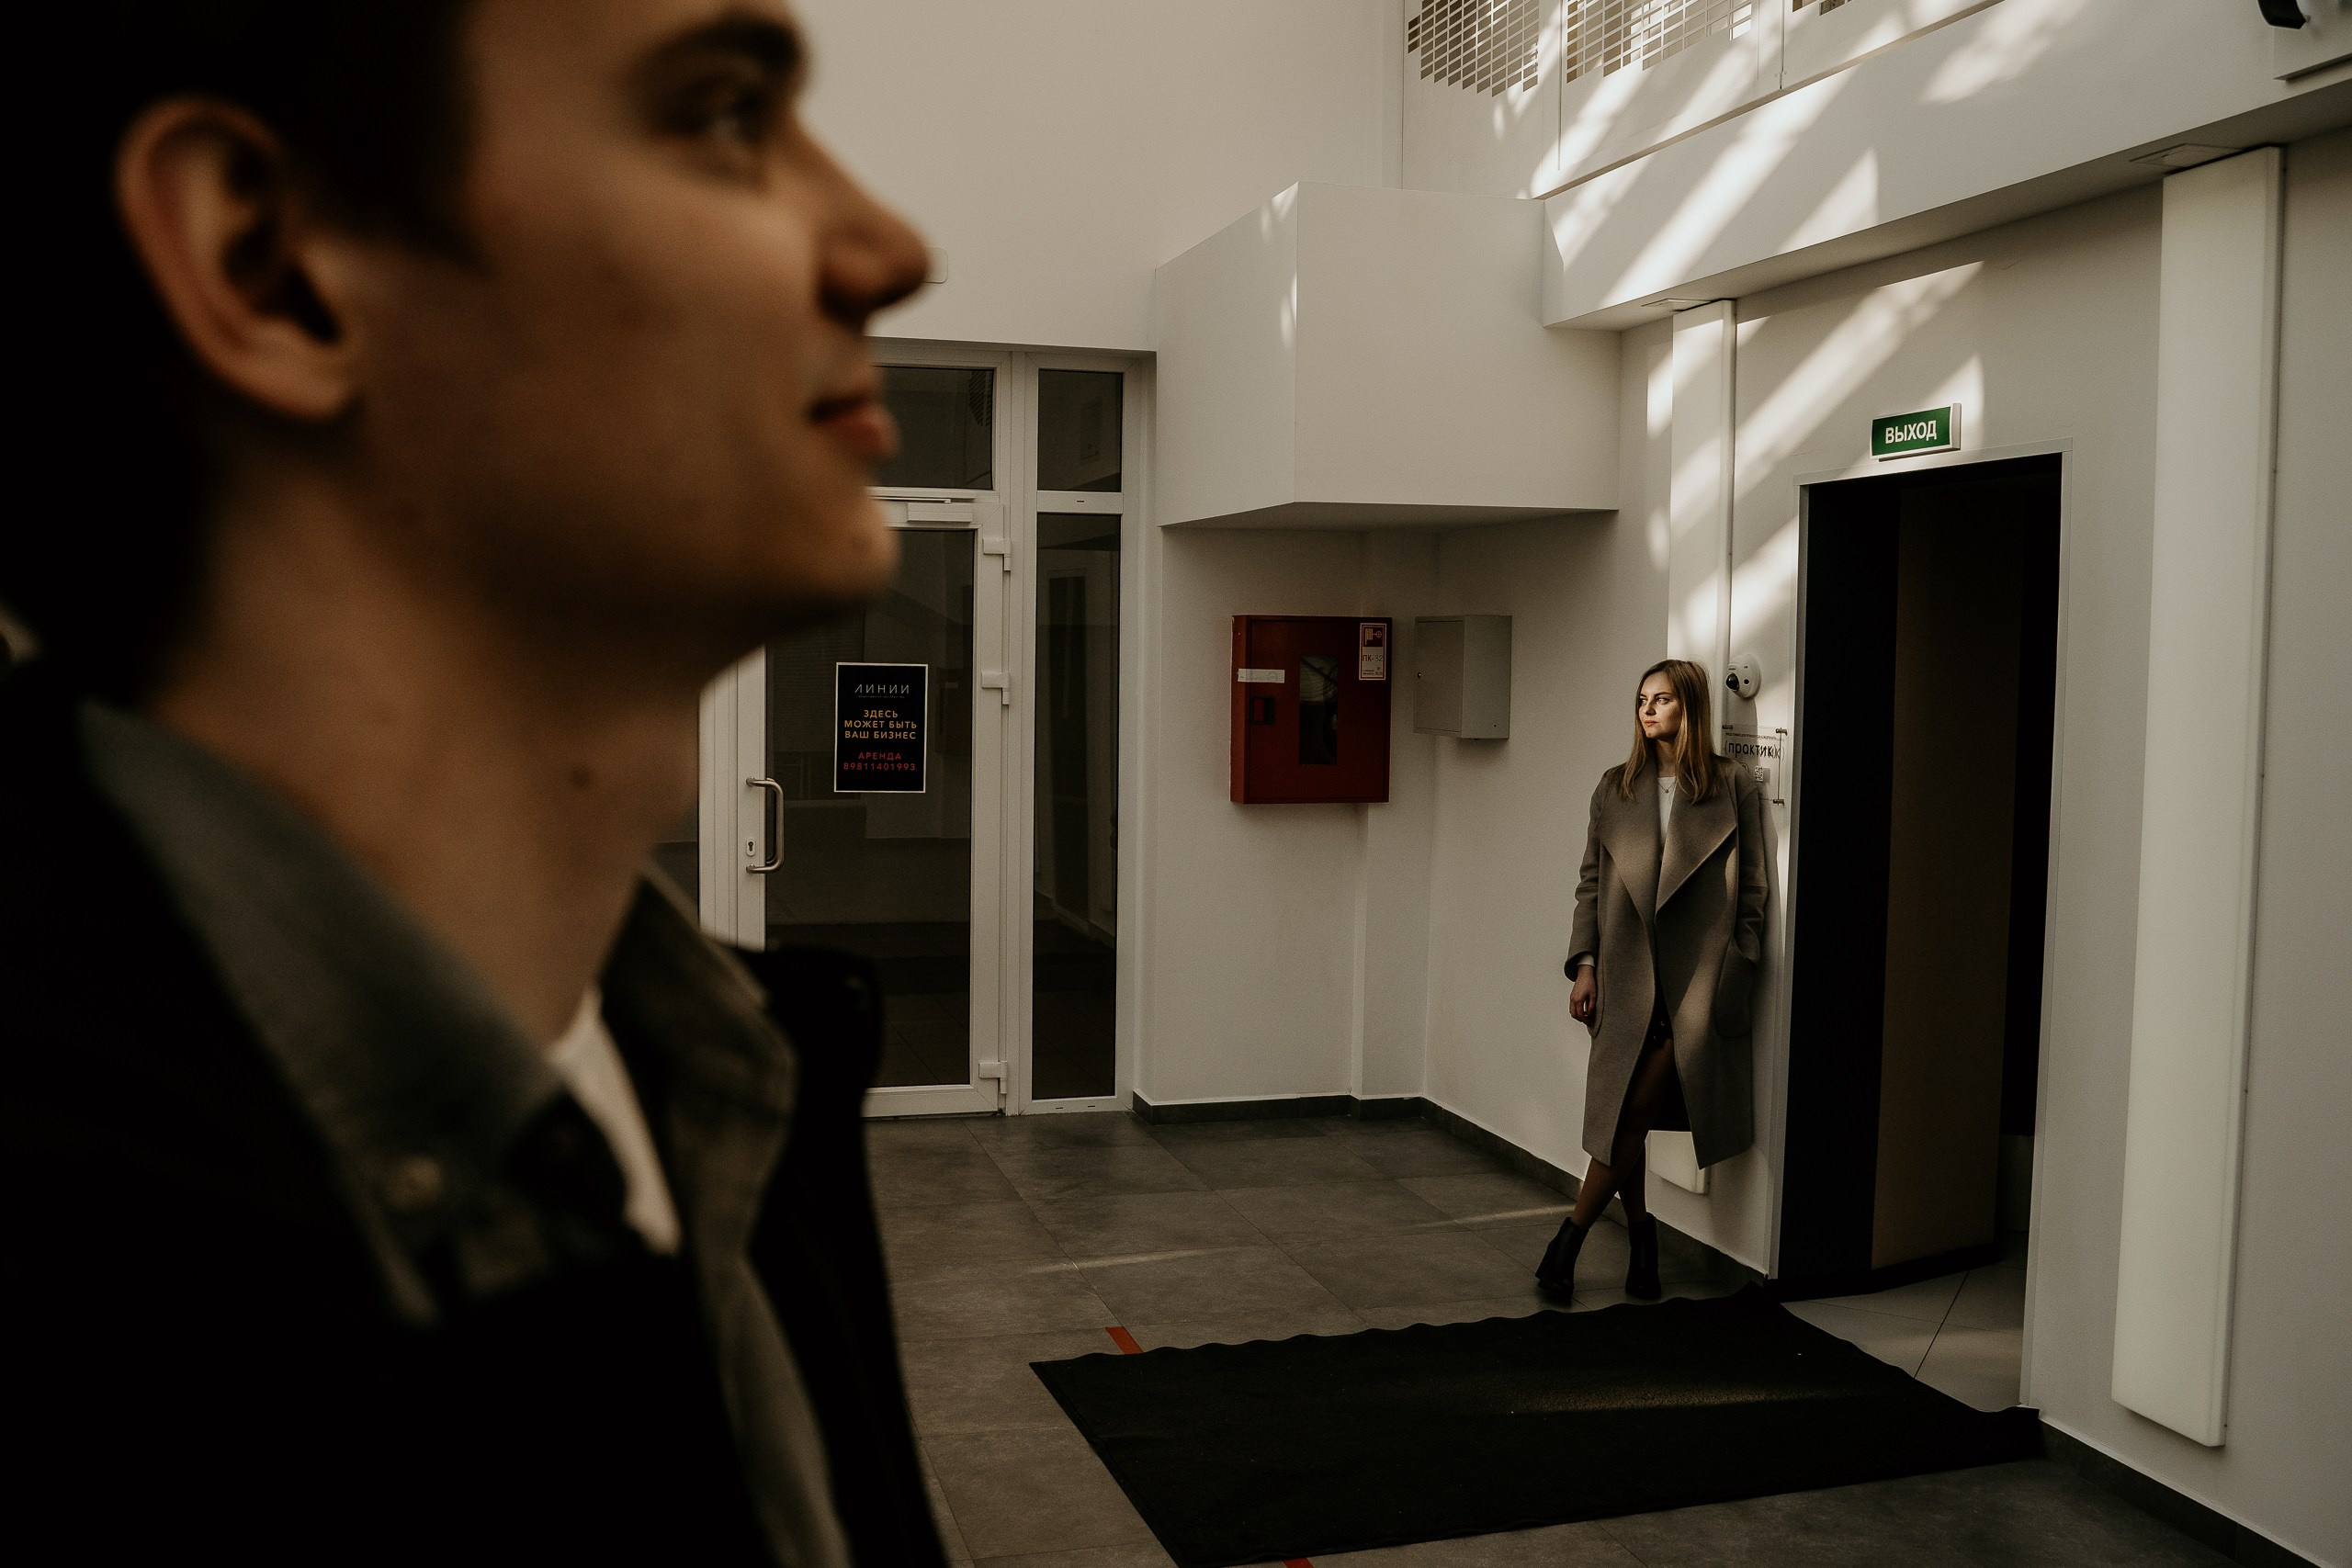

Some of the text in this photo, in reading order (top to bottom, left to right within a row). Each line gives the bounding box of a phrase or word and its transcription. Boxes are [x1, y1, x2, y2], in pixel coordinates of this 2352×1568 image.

[1885, 420, 1937, 444] ВЫХОД
[854, 683, 910, 694] ЛИНИИ
[864, 709, 898, 718] ЗДЕСЬ
[844, 720, 917, 729] МОЖЕТ БЫТЬ
[874, 731, 916, 739] БИЗНЕС
[857, 751, 901, 761] АРЕНДА
[843, 762, 916, 771] 89811401993
